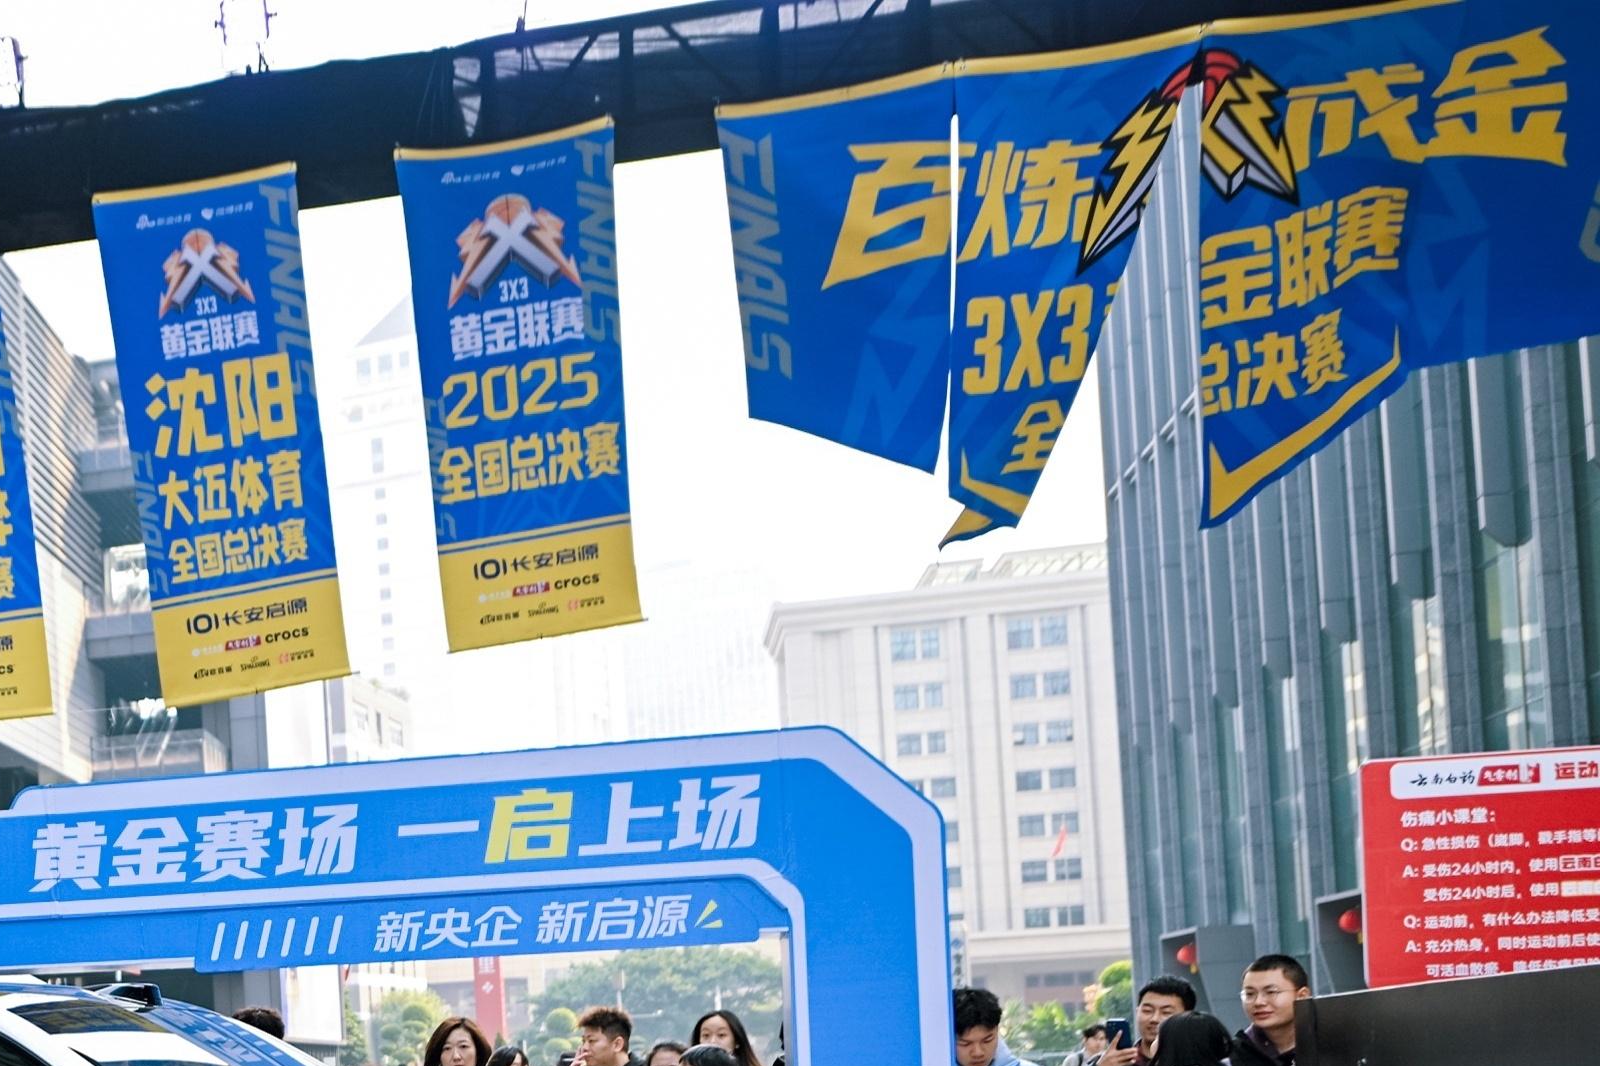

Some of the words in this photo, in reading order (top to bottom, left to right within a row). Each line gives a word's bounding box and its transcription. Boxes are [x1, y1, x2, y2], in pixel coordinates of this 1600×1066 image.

[822, 138, 1103, 290] 百炼
[1285, 26, 1568, 167] 成金
[498, 277, 529, 301] 3X3
[717, 131, 793, 380] FINALS
[194, 296, 218, 316] 3X3
[449, 296, 586, 362] 黄金联赛
[962, 281, 1122, 395] 3X3
[160, 321, 260, 361] 黄金联赛
[144, 352, 299, 458] 沈阳
[443, 351, 600, 430] 2025
[158, 449, 304, 530] 大迈体育
[439, 421, 621, 505] 全国总决赛
[168, 517, 310, 585] 全国总决赛
[553, 574, 600, 591] crocs
[265, 627, 310, 644] crocs
[1554, 760, 1599, 781] 运动
[29, 804, 359, 893] 黄金赛场
[397, 774, 761, 865] 一启上场
[373, 905, 522, 953] 新央企
[535, 894, 692, 945] 新启源
